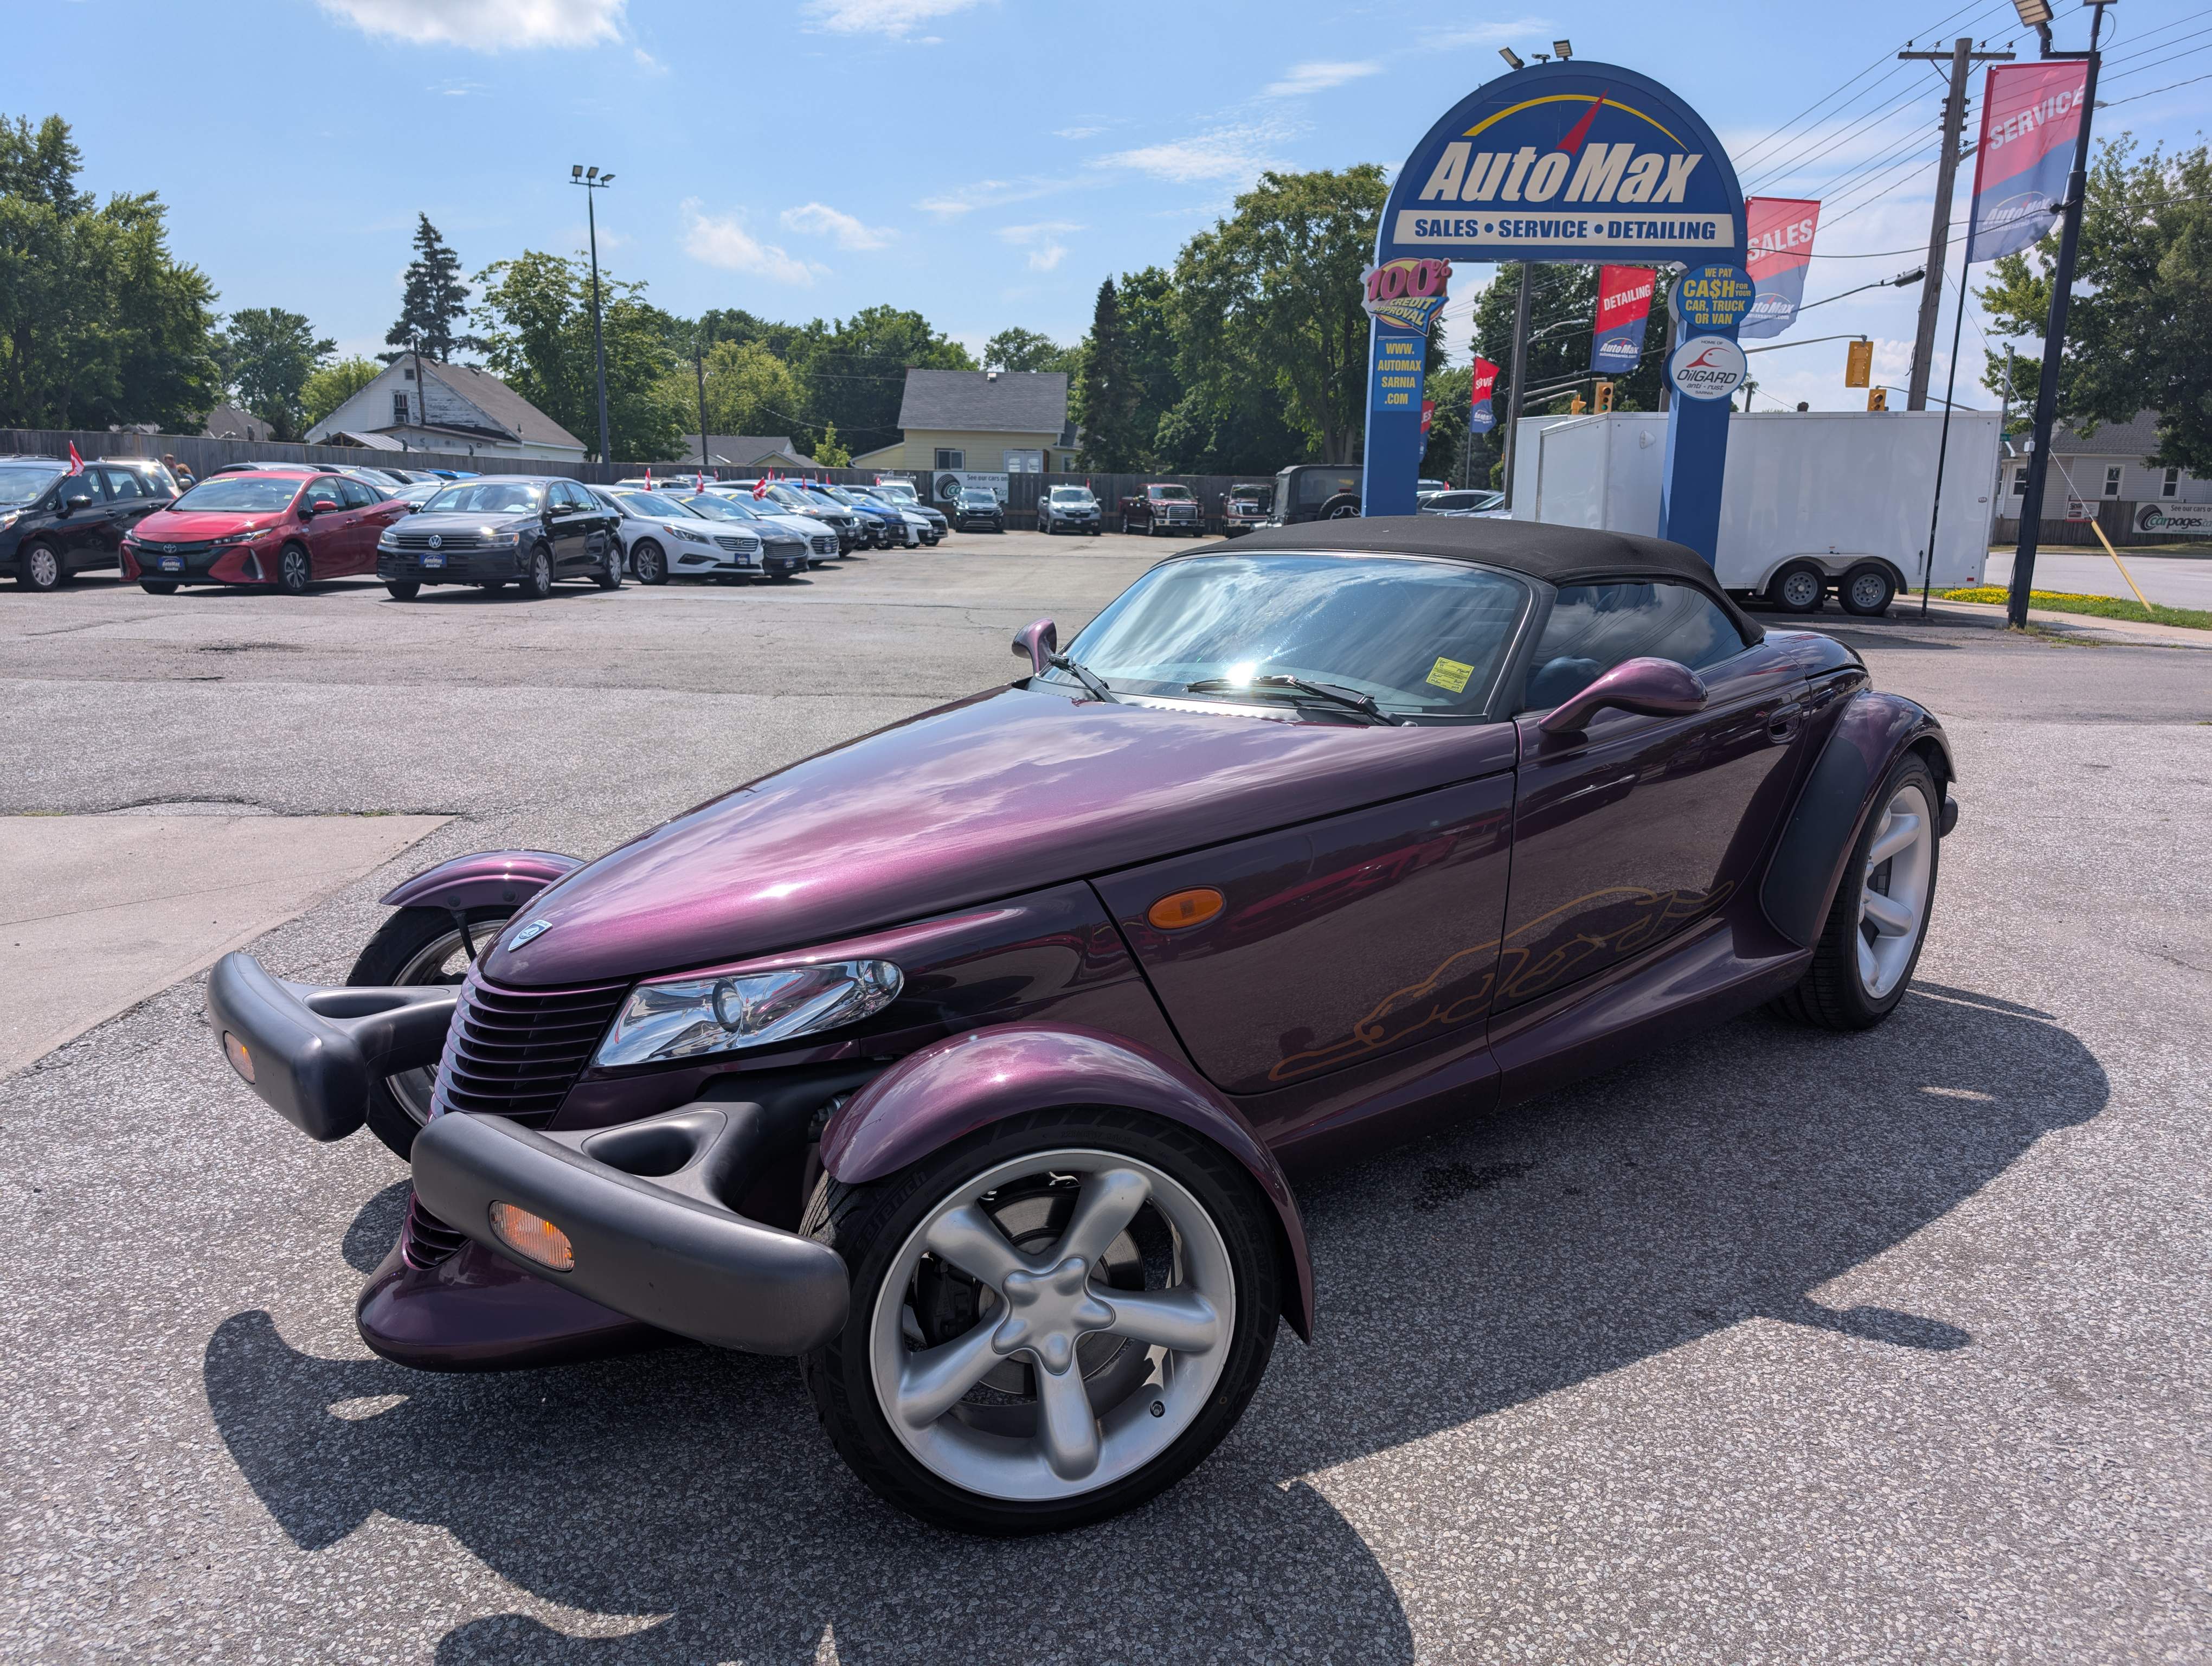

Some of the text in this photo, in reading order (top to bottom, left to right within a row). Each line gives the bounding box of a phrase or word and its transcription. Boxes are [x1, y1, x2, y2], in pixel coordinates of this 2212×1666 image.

[1990, 84, 2086, 150] SERVICE
[1418, 142, 1703, 203] AutoMax
[1414, 219, 1716, 240] SALES SERVICE DETAILING
[1747, 218, 1813, 261] SALES
[1705, 268, 1733, 278] WE PAY
[1367, 258, 1453, 303] 100%
[1683, 279, 1735, 299] CA$H
[1390, 298, 1437, 311] CREDIT
[1603, 284, 1651, 311] DETAILING
[1685, 299, 1745, 312] CAR, TRUCK
[1373, 306, 1426, 326] APPROVAL
[1695, 313, 1733, 324] OR VAN
[1386, 343, 1414, 354] WWW.
[1599, 342, 1639, 354] AutoMax
[1378, 360, 1422, 371] AUTOMAX
[1381, 376, 1416, 388] SARNIA
[1677, 369, 1738, 384] OilGARD
[1384, 393, 1409, 405] .COM
